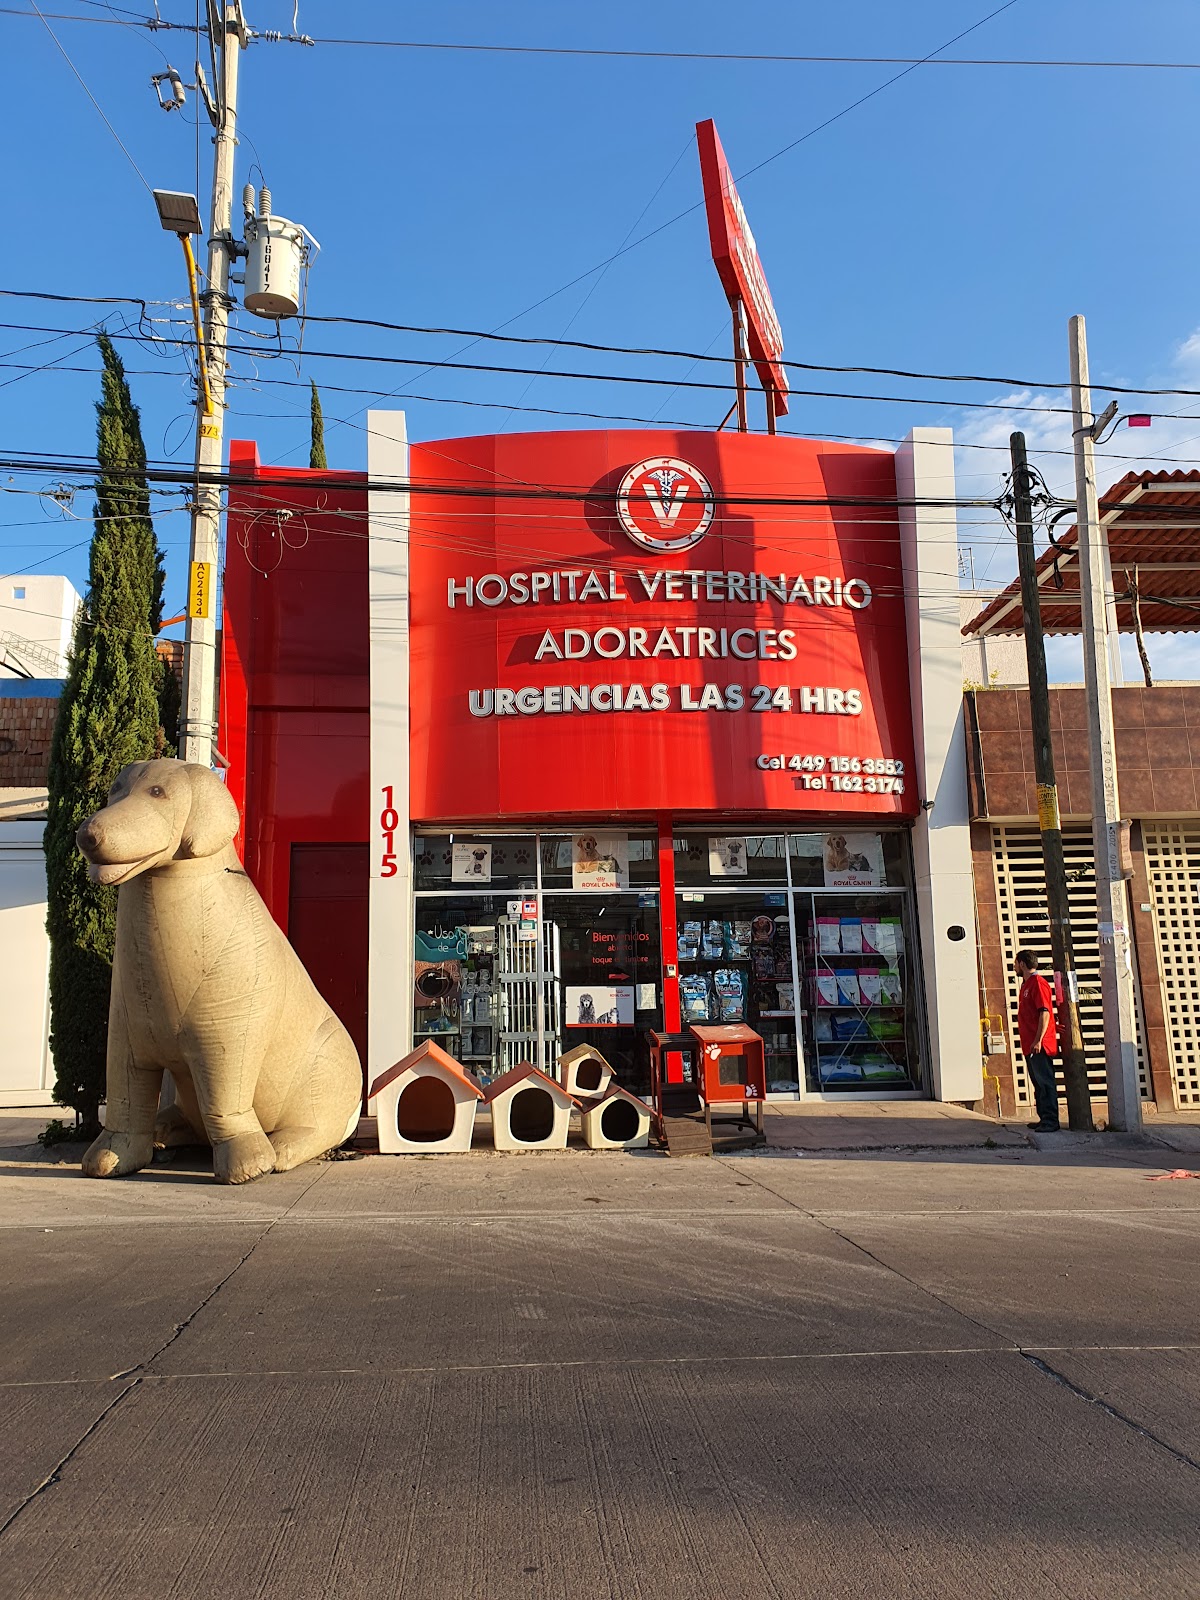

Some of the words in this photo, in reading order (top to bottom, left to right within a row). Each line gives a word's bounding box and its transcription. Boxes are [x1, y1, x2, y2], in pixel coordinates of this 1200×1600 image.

[196, 562, 205, 615] AC2434
[447, 569, 627, 608] HOSPITAL
[637, 569, 872, 609] VETERINARIO
[534, 626, 798, 661] ADORATRICES
[468, 683, 671, 717] URGENCIAS
[680, 683, 745, 711] LAS
[751, 684, 793, 712] 24
[800, 686, 863, 715] HRS
[757, 754, 785, 769] Cel
[788, 754, 826, 771] 449
[802, 774, 827, 790] Tel
[380, 786, 399, 877] 1015
[592, 932, 649, 942] Bienvenidos
[592, 956, 612, 965] toque
